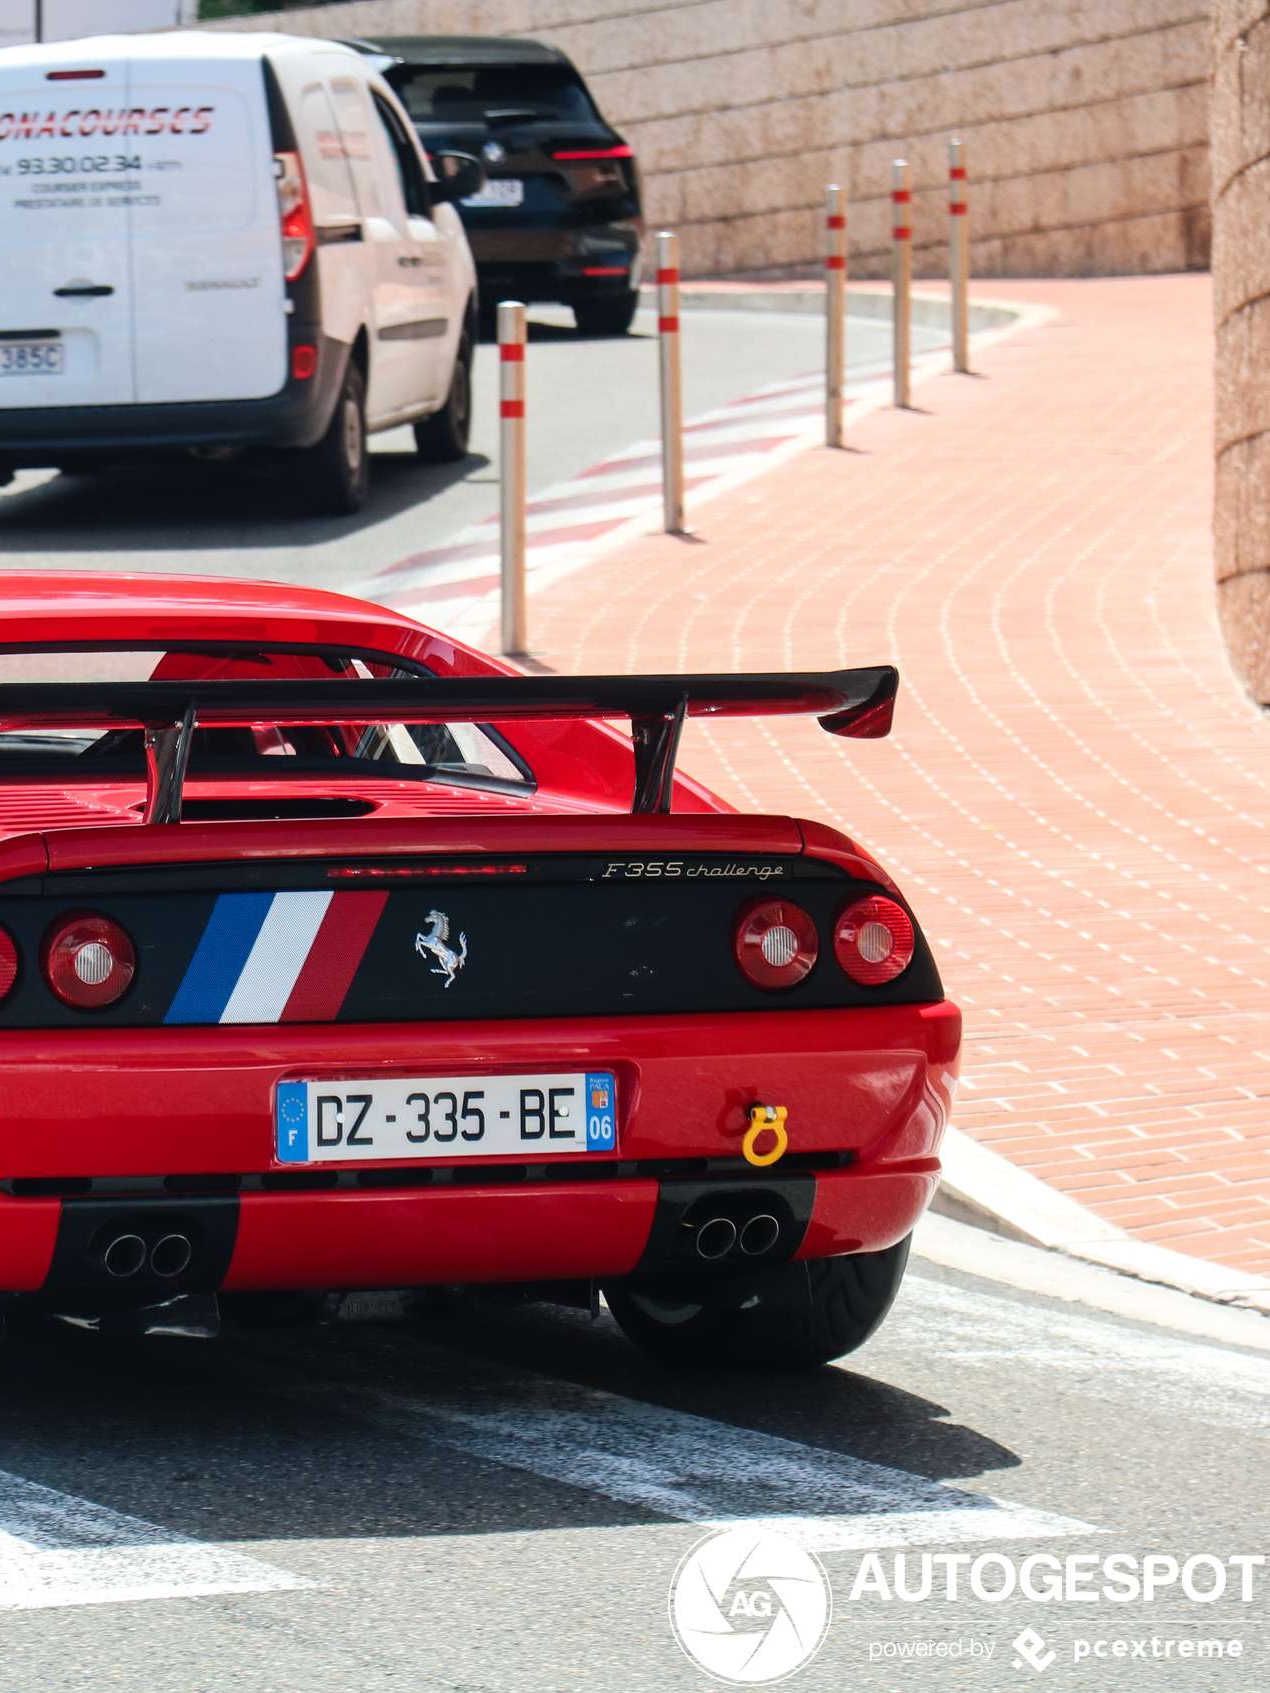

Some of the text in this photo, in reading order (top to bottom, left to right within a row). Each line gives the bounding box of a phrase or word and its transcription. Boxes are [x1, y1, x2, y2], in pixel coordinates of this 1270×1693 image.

[91, 180, 141, 192] EXPRESS
[108, 196, 161, 208] SERVICES
[1, 346, 59, 370] 385C
[602, 862, 784, 880] F355 challenge
[590, 1115, 612, 1140] 06
[289, 1130, 298, 1146] F
